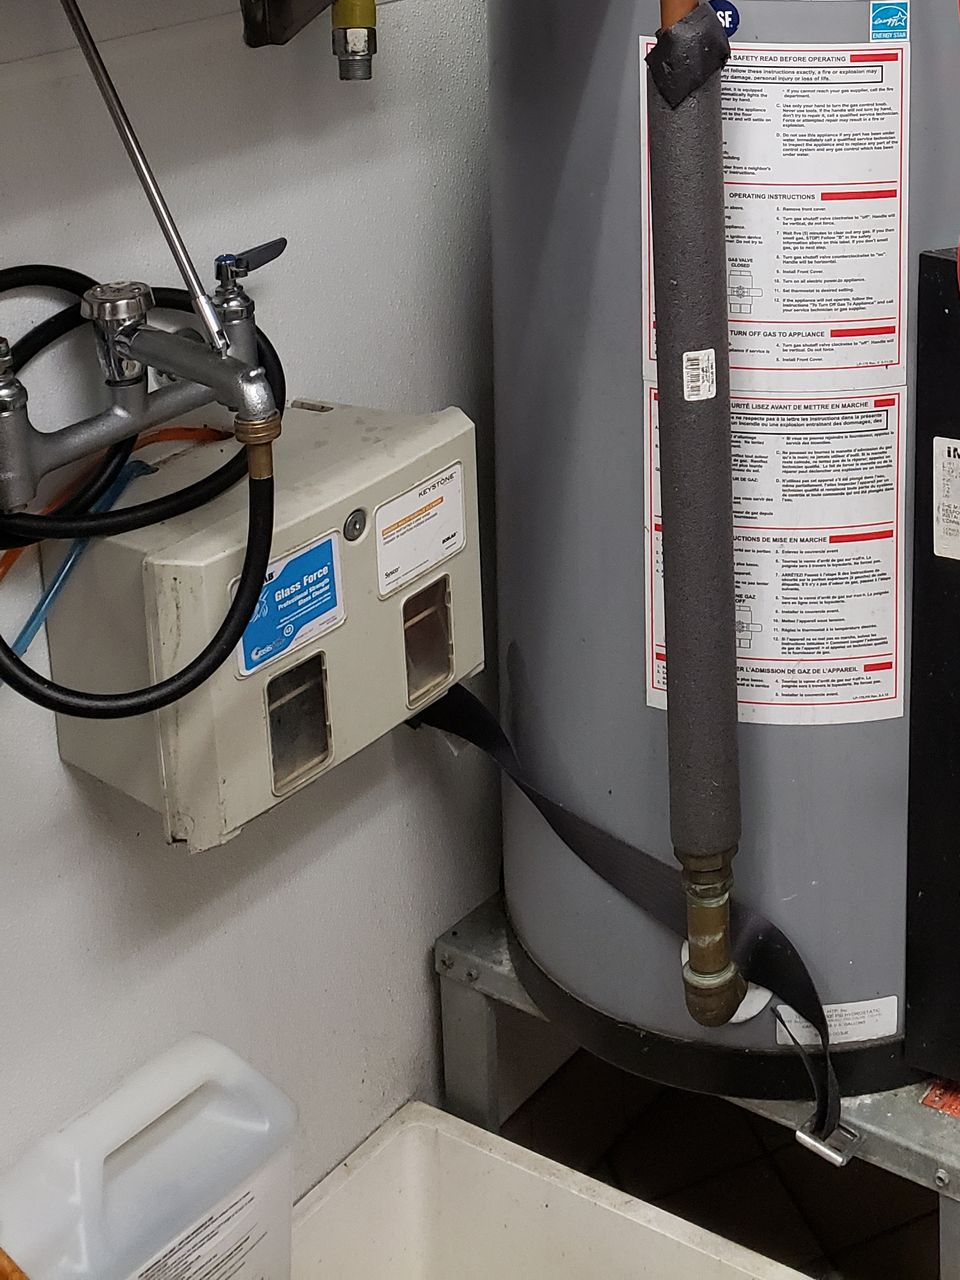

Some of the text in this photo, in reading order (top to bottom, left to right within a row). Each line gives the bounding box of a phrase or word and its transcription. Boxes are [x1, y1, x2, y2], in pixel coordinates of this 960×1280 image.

[275, 566, 329, 602] Glass Force
[277, 589, 308, 611] Professional
[298, 595, 311, 606] Glass
